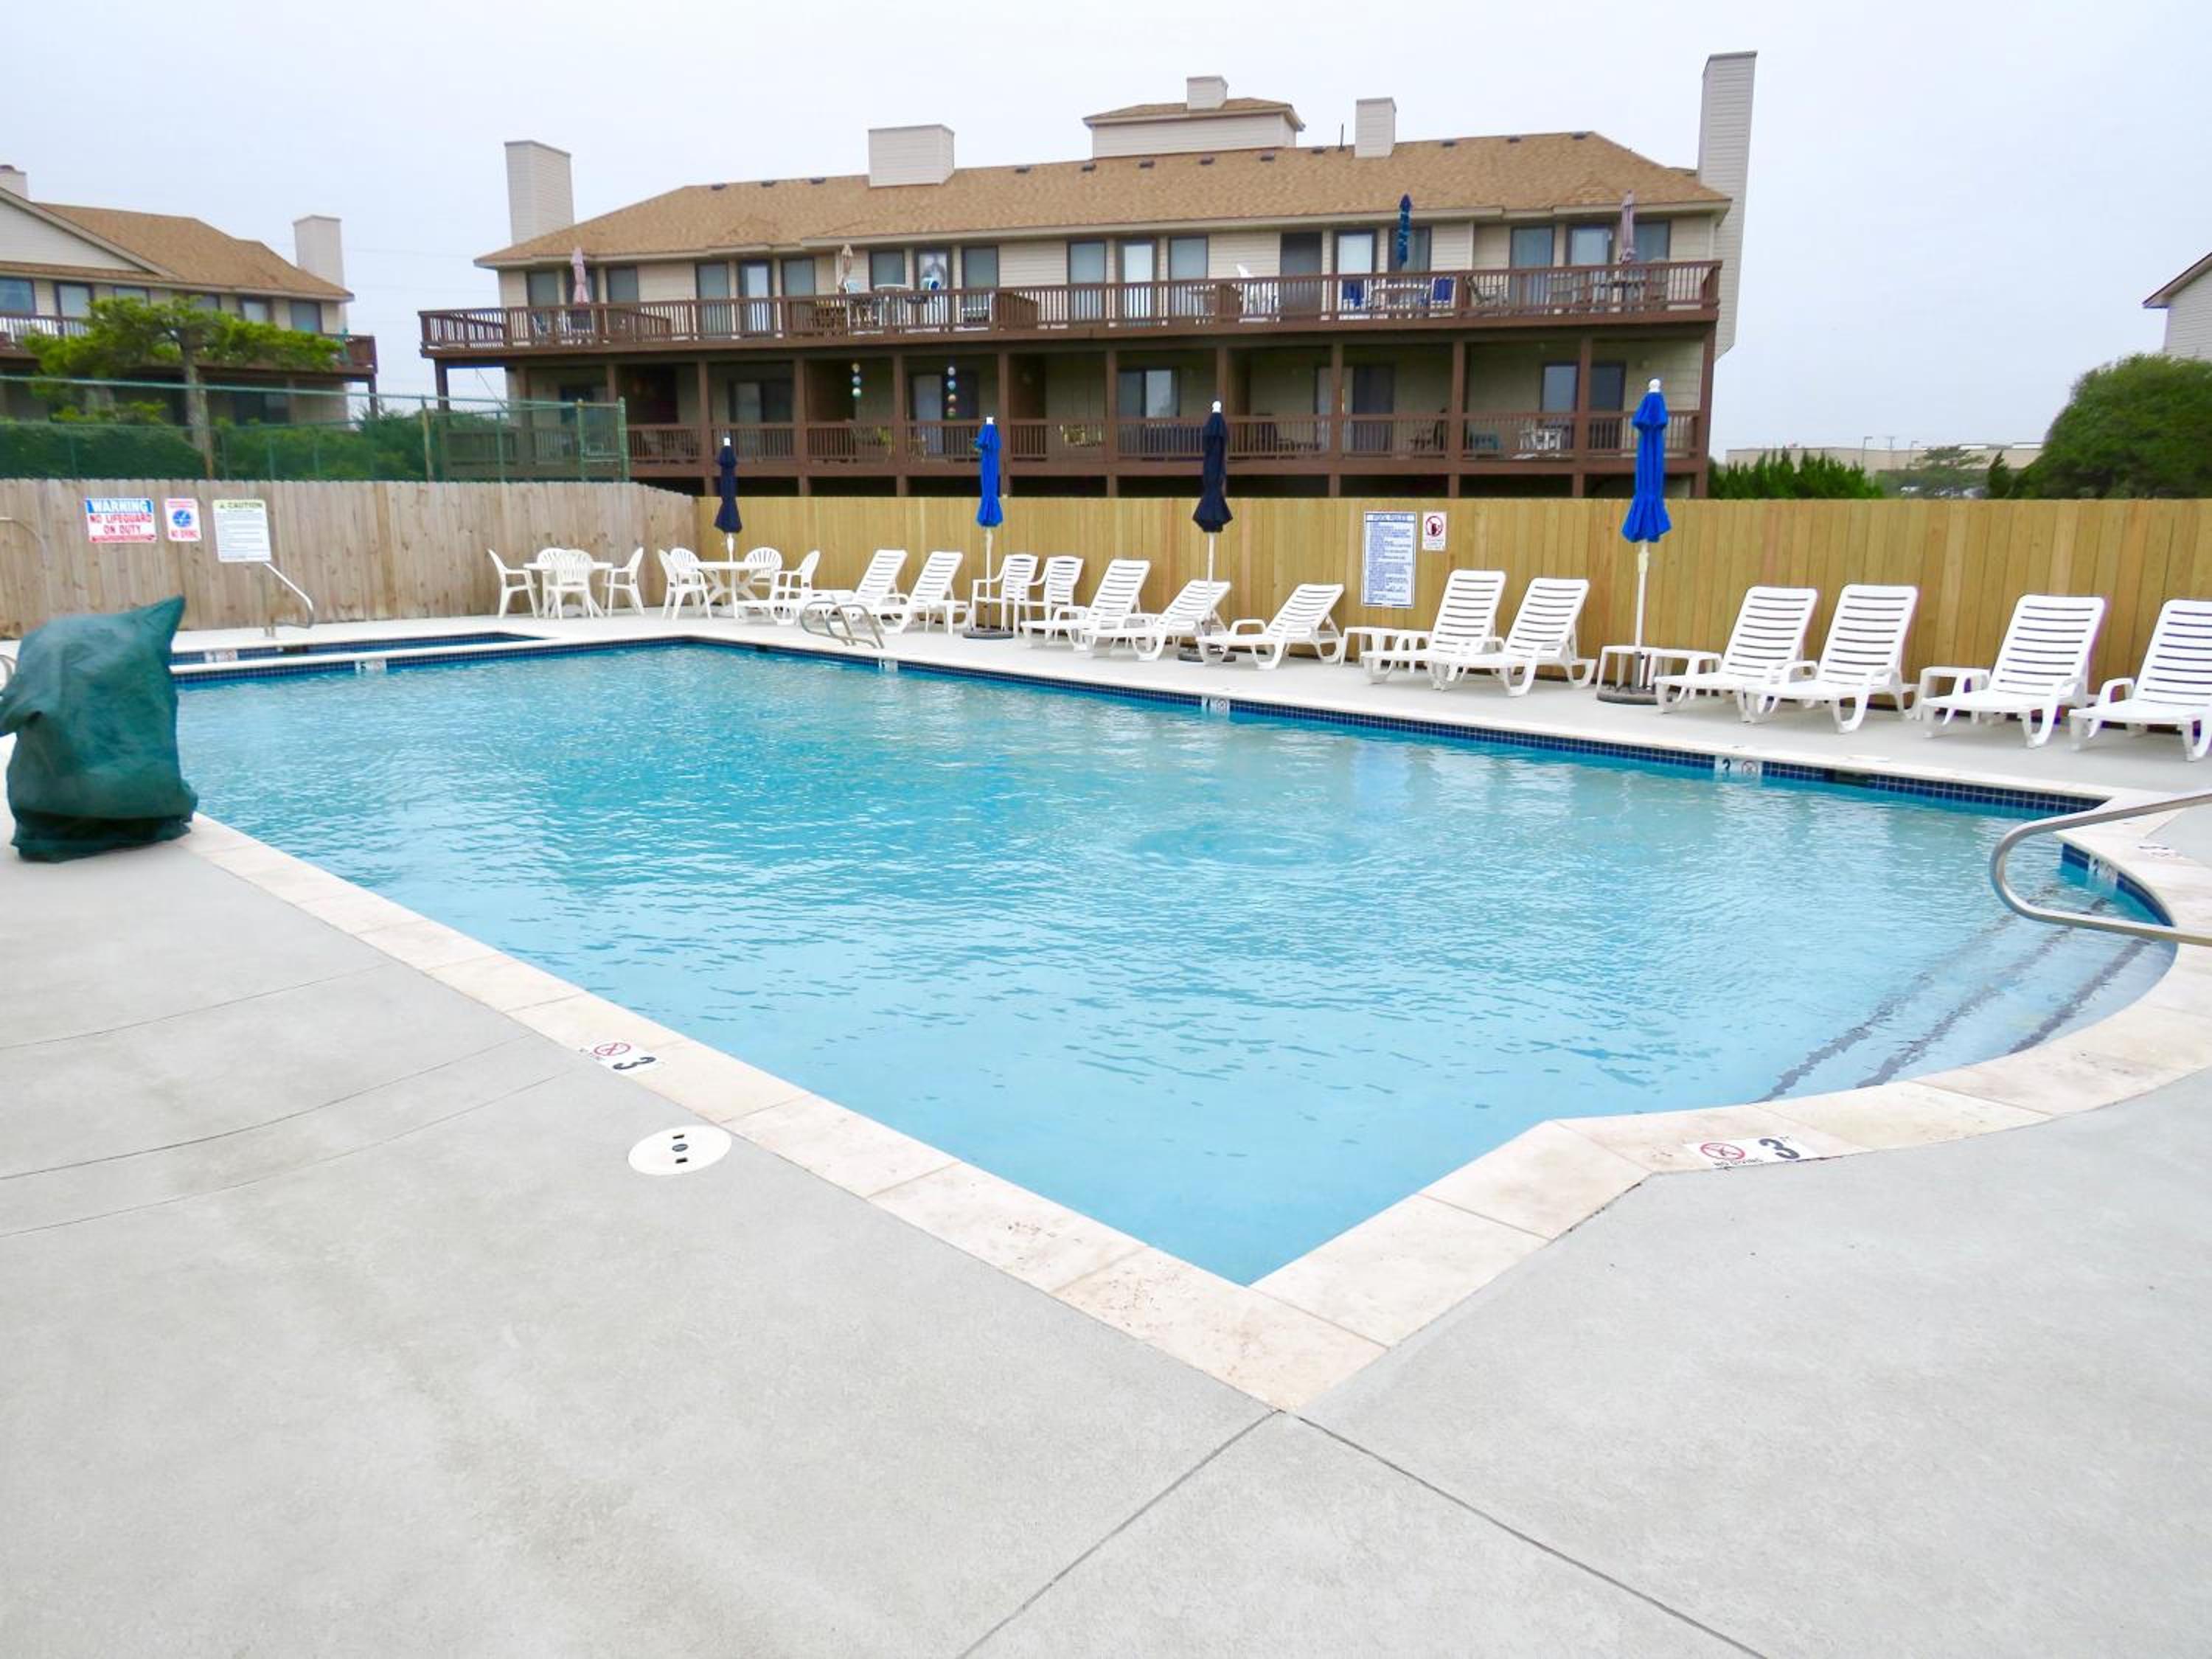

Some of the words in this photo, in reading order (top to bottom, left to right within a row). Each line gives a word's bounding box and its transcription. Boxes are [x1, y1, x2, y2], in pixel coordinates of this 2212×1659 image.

[93, 500, 149, 512] WARNING
[90, 514, 102, 523] NO
[106, 514, 152, 523] LIFEGUARD
[103, 525, 115, 534] ON
[119, 525, 141, 534] DUTY
[613, 1057, 656, 1070] 3
[1759, 1138, 1800, 1159] 3
